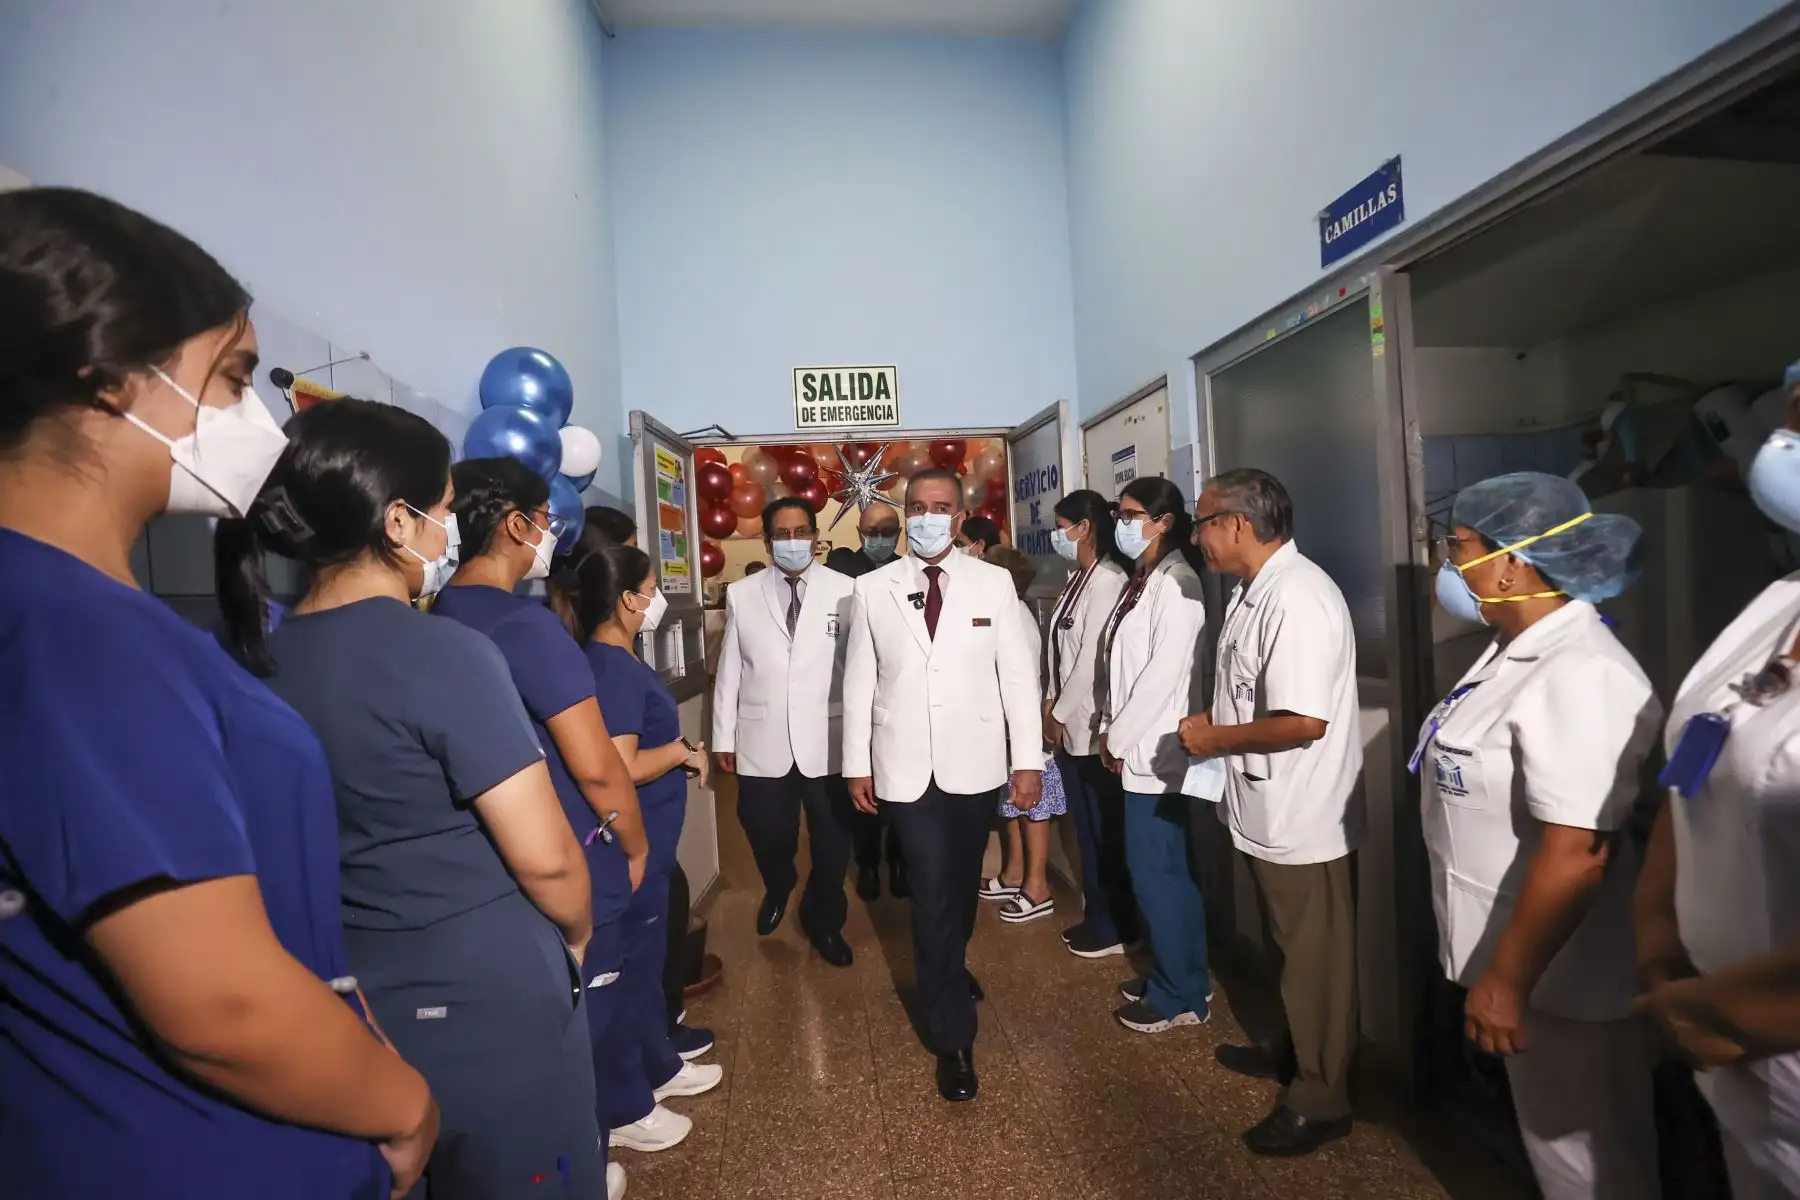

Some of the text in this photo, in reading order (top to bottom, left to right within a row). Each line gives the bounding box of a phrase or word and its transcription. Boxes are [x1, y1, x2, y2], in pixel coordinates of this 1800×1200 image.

[1325, 183, 1397, 244] CAMILLAS
[802, 372, 891, 402] SALIDA
[802, 404, 894, 423] DE EMERGENCIA
[1014, 464, 1058, 503] SERVICIO
[1030, 500, 1042, 525] DE
